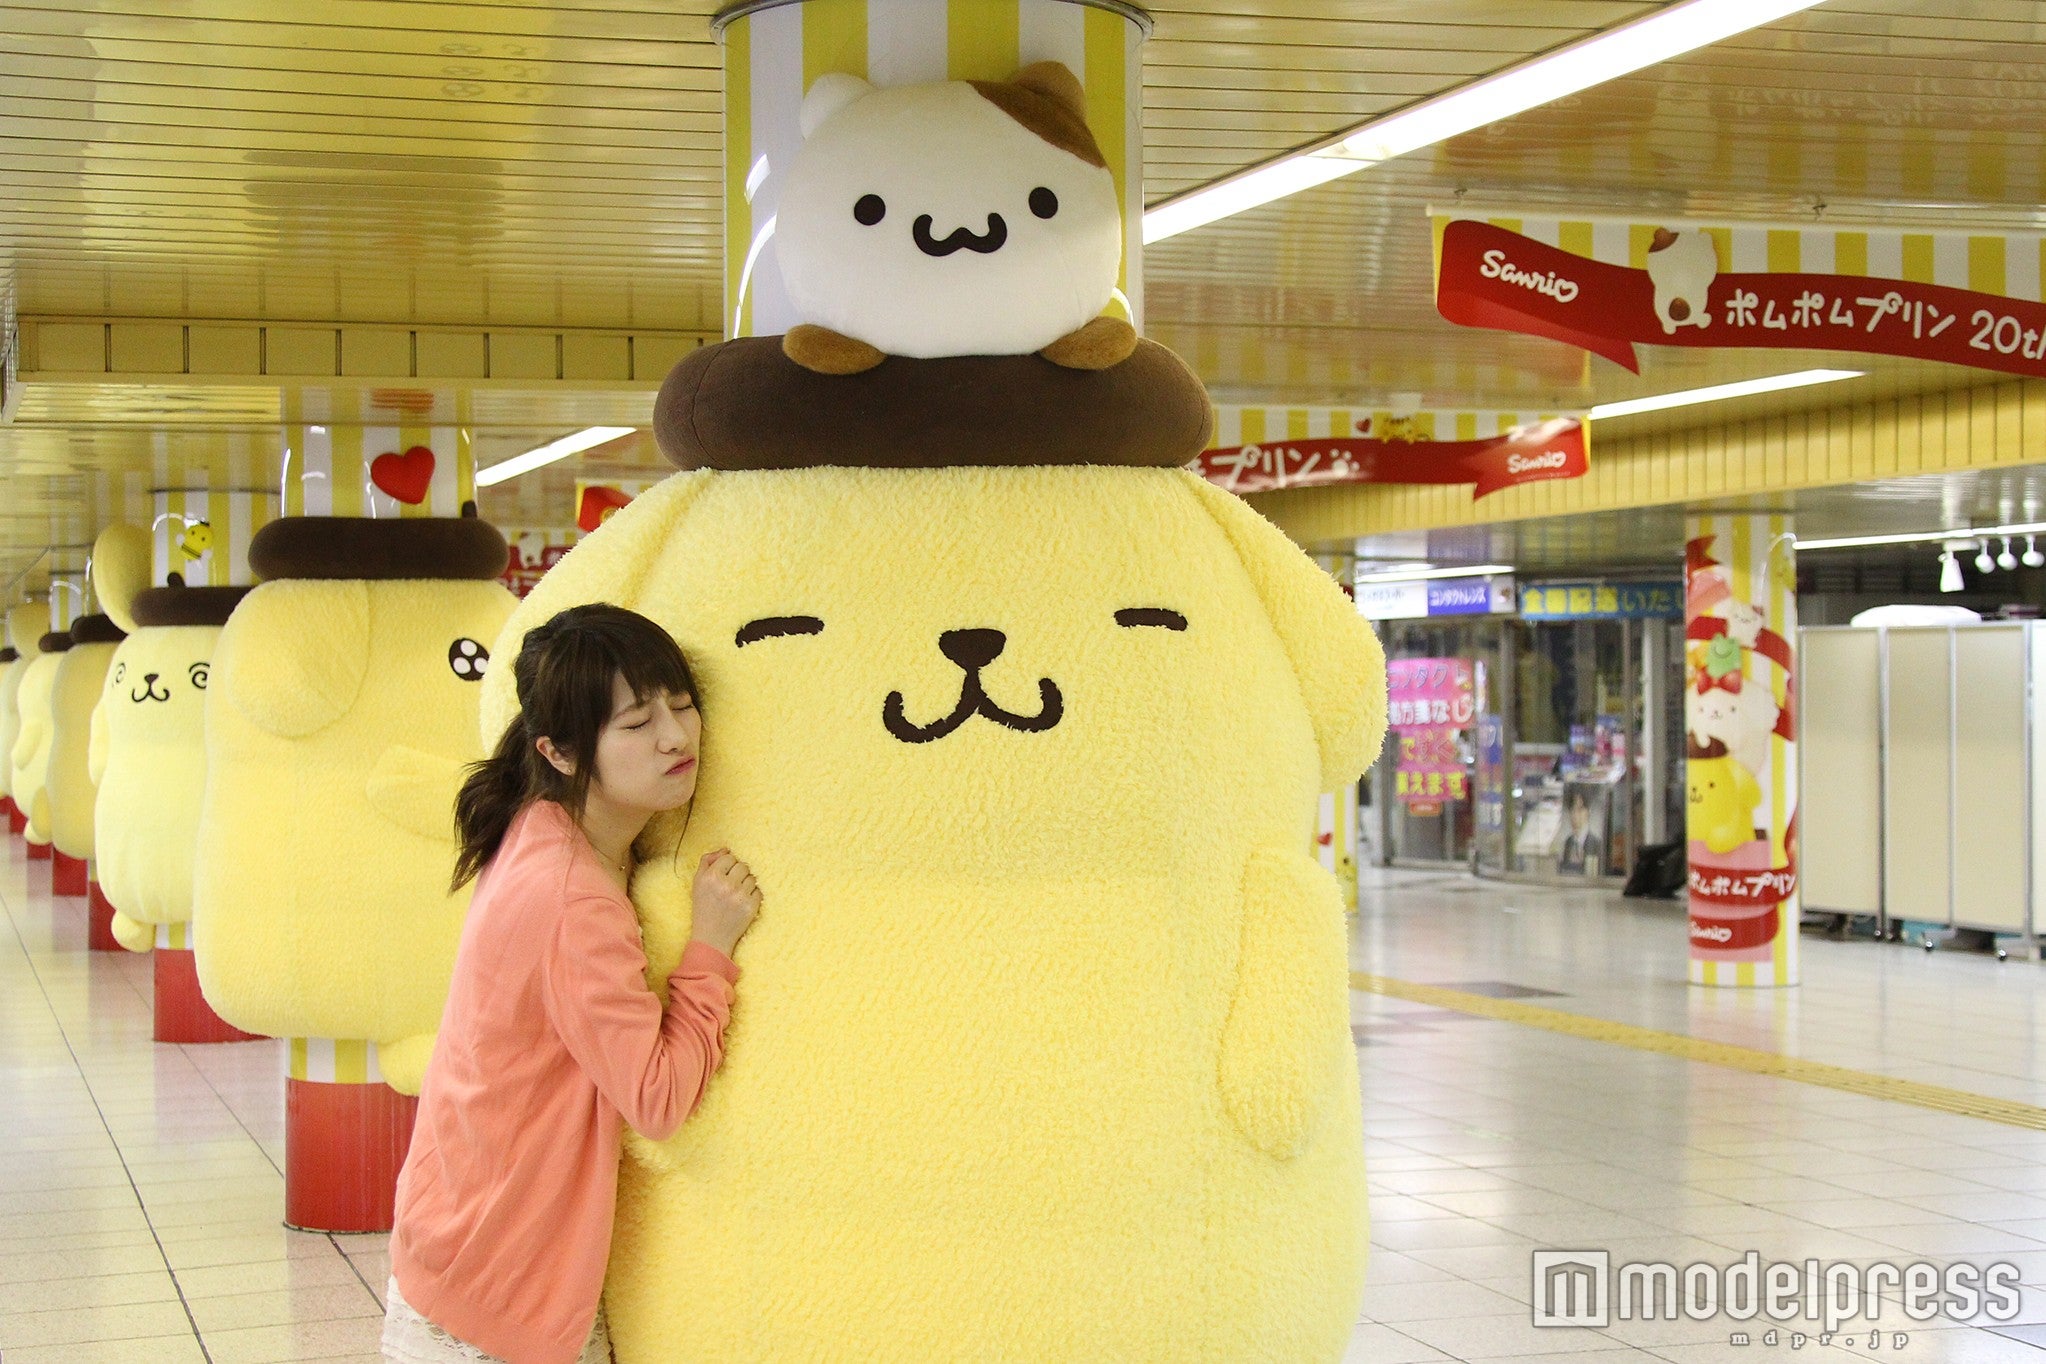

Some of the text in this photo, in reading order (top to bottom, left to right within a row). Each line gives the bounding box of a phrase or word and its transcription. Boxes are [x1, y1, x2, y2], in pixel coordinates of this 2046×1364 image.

[1480, 249, 1579, 303] Sanrio
[1725, 287, 1957, 340] ポムポムプリン
[1507, 450, 1567, 474] Sanrio
